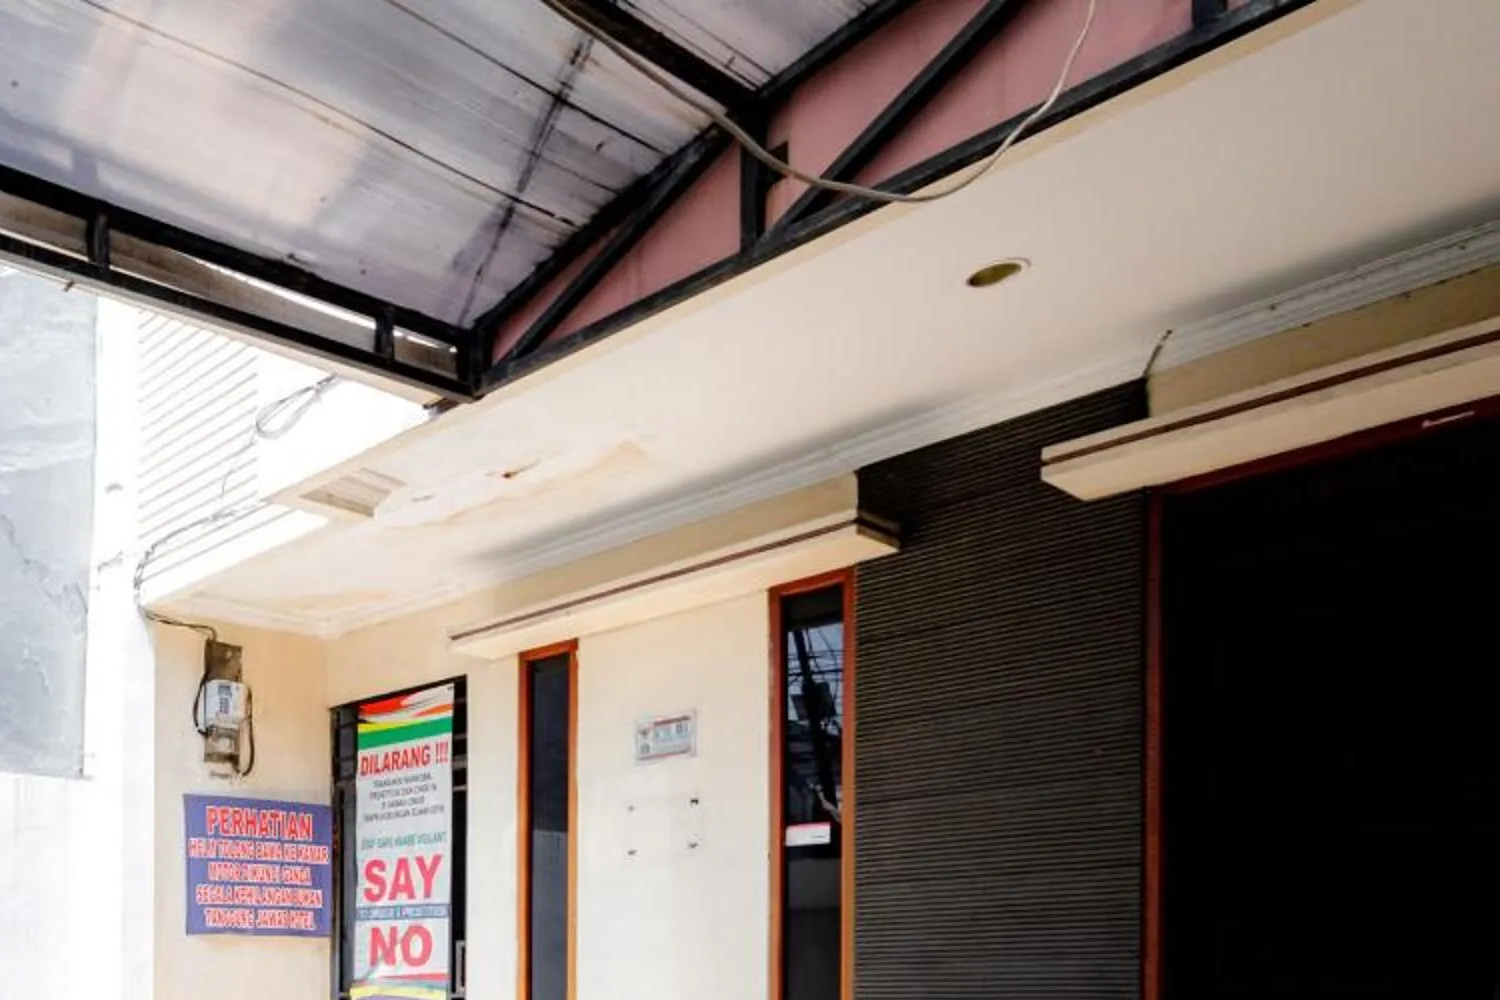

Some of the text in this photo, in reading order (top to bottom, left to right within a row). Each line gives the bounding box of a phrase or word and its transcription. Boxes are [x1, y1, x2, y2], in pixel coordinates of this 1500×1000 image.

[361, 745, 431, 776] DILARANG
[205, 804, 314, 842] PERHATIAN
[363, 853, 443, 903] SAY
[369, 923, 433, 969] NO
